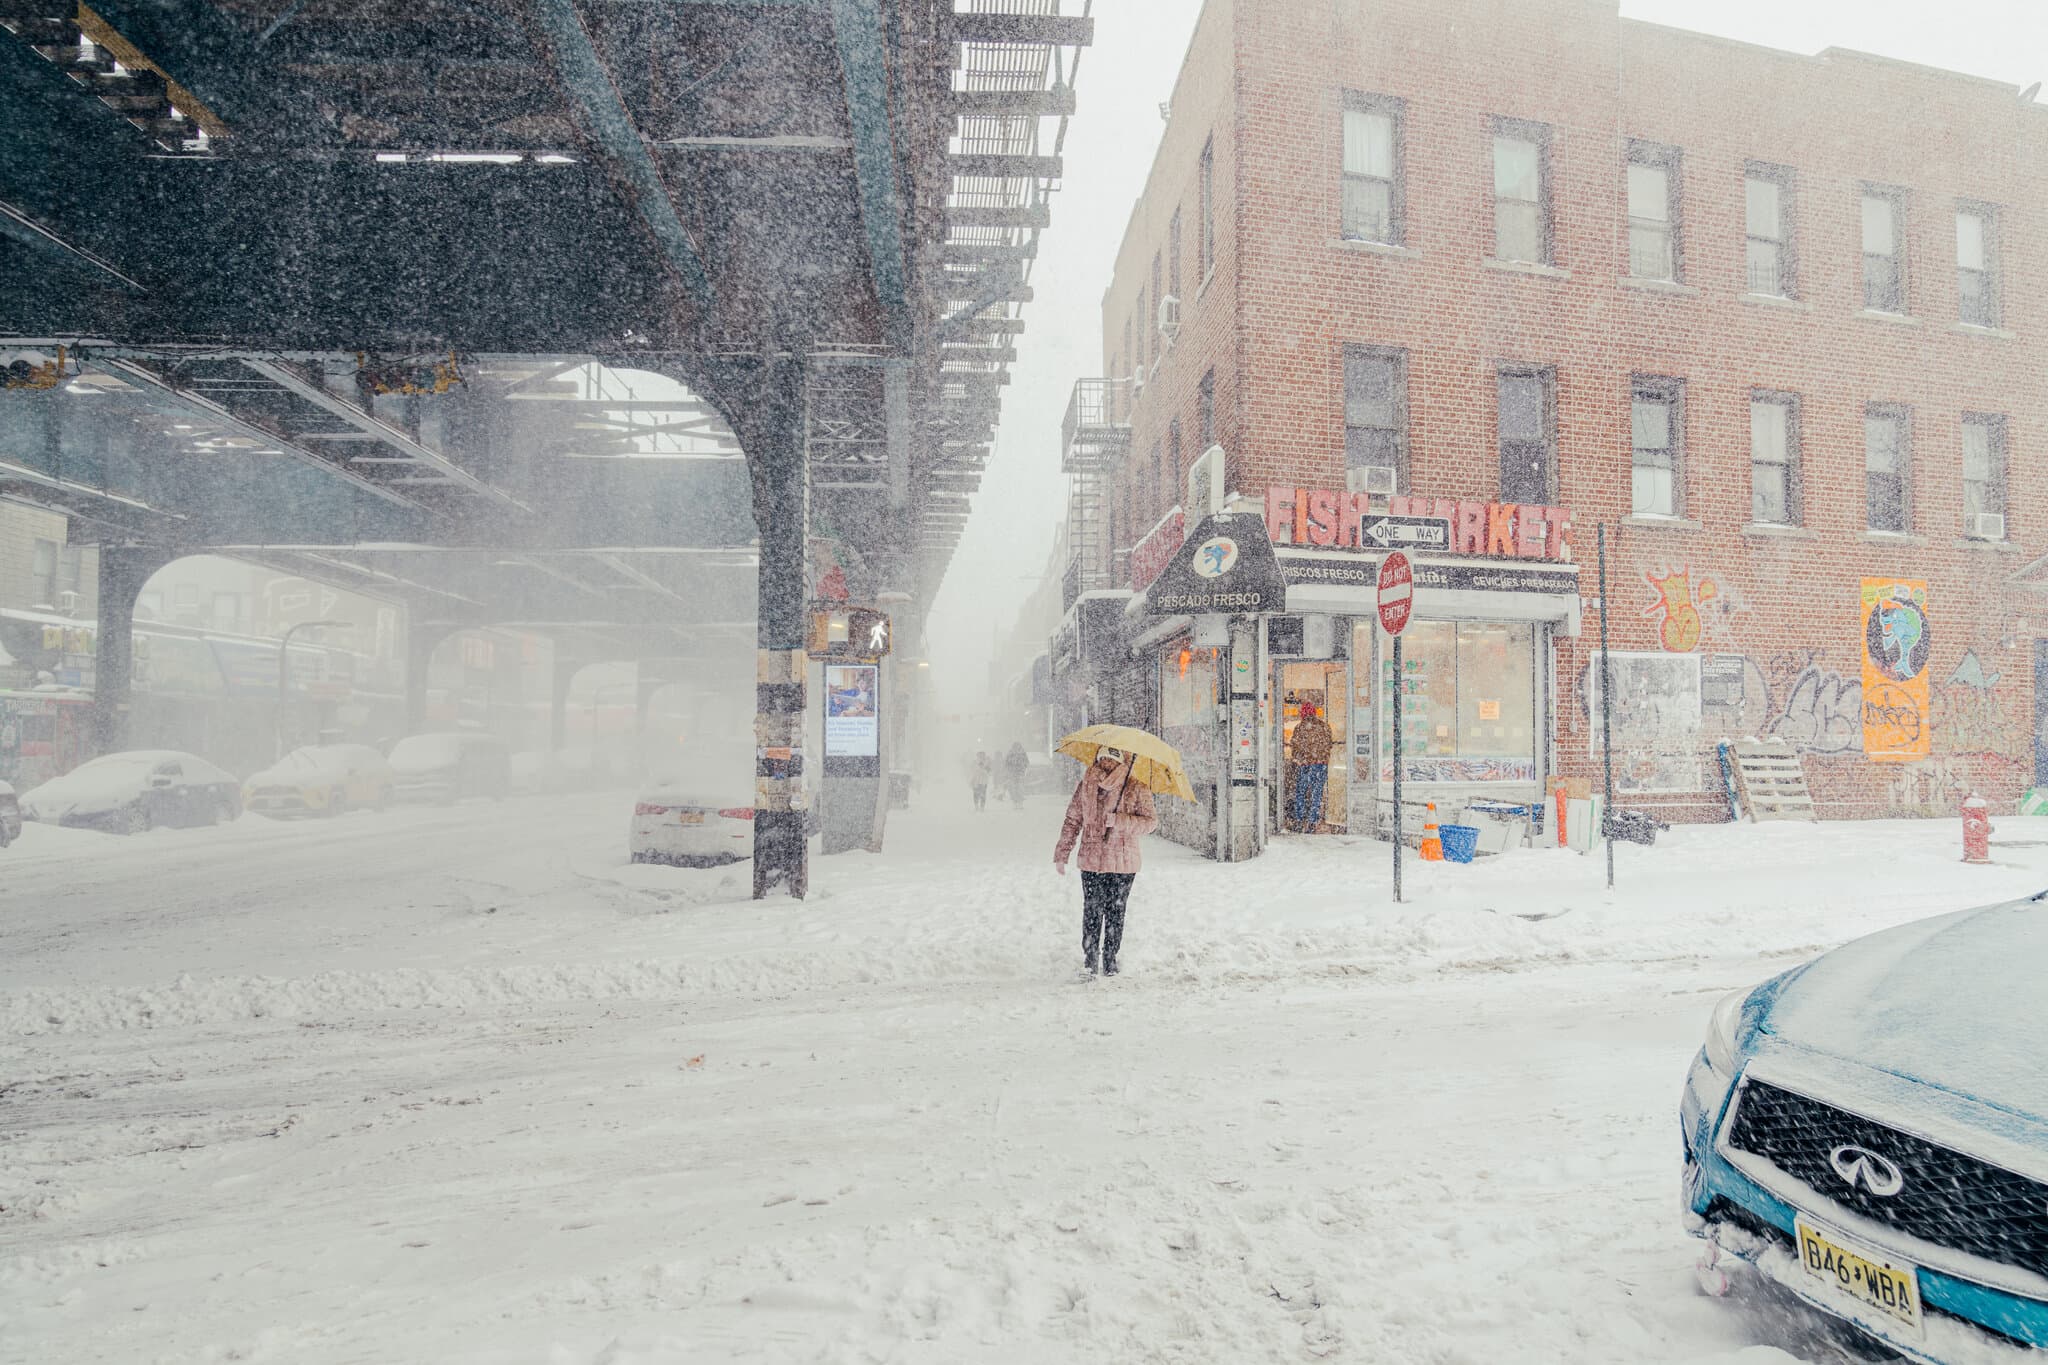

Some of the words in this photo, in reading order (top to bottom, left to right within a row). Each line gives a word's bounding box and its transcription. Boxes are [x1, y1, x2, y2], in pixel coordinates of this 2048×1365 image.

[1265, 486, 1369, 548] FISH
[1376, 525, 1399, 539] ONE
[1416, 526, 1440, 541] WAY
[1323, 568, 1364, 580] FRESCO
[1383, 571, 1393, 587] DO
[1394, 565, 1408, 580] NOT
[1473, 575, 1519, 588] CEVICHES
[1157, 595, 1211, 607] PESCADO
[1213, 592, 1261, 606] FRESCO
[1385, 603, 1406, 620] ENTER
